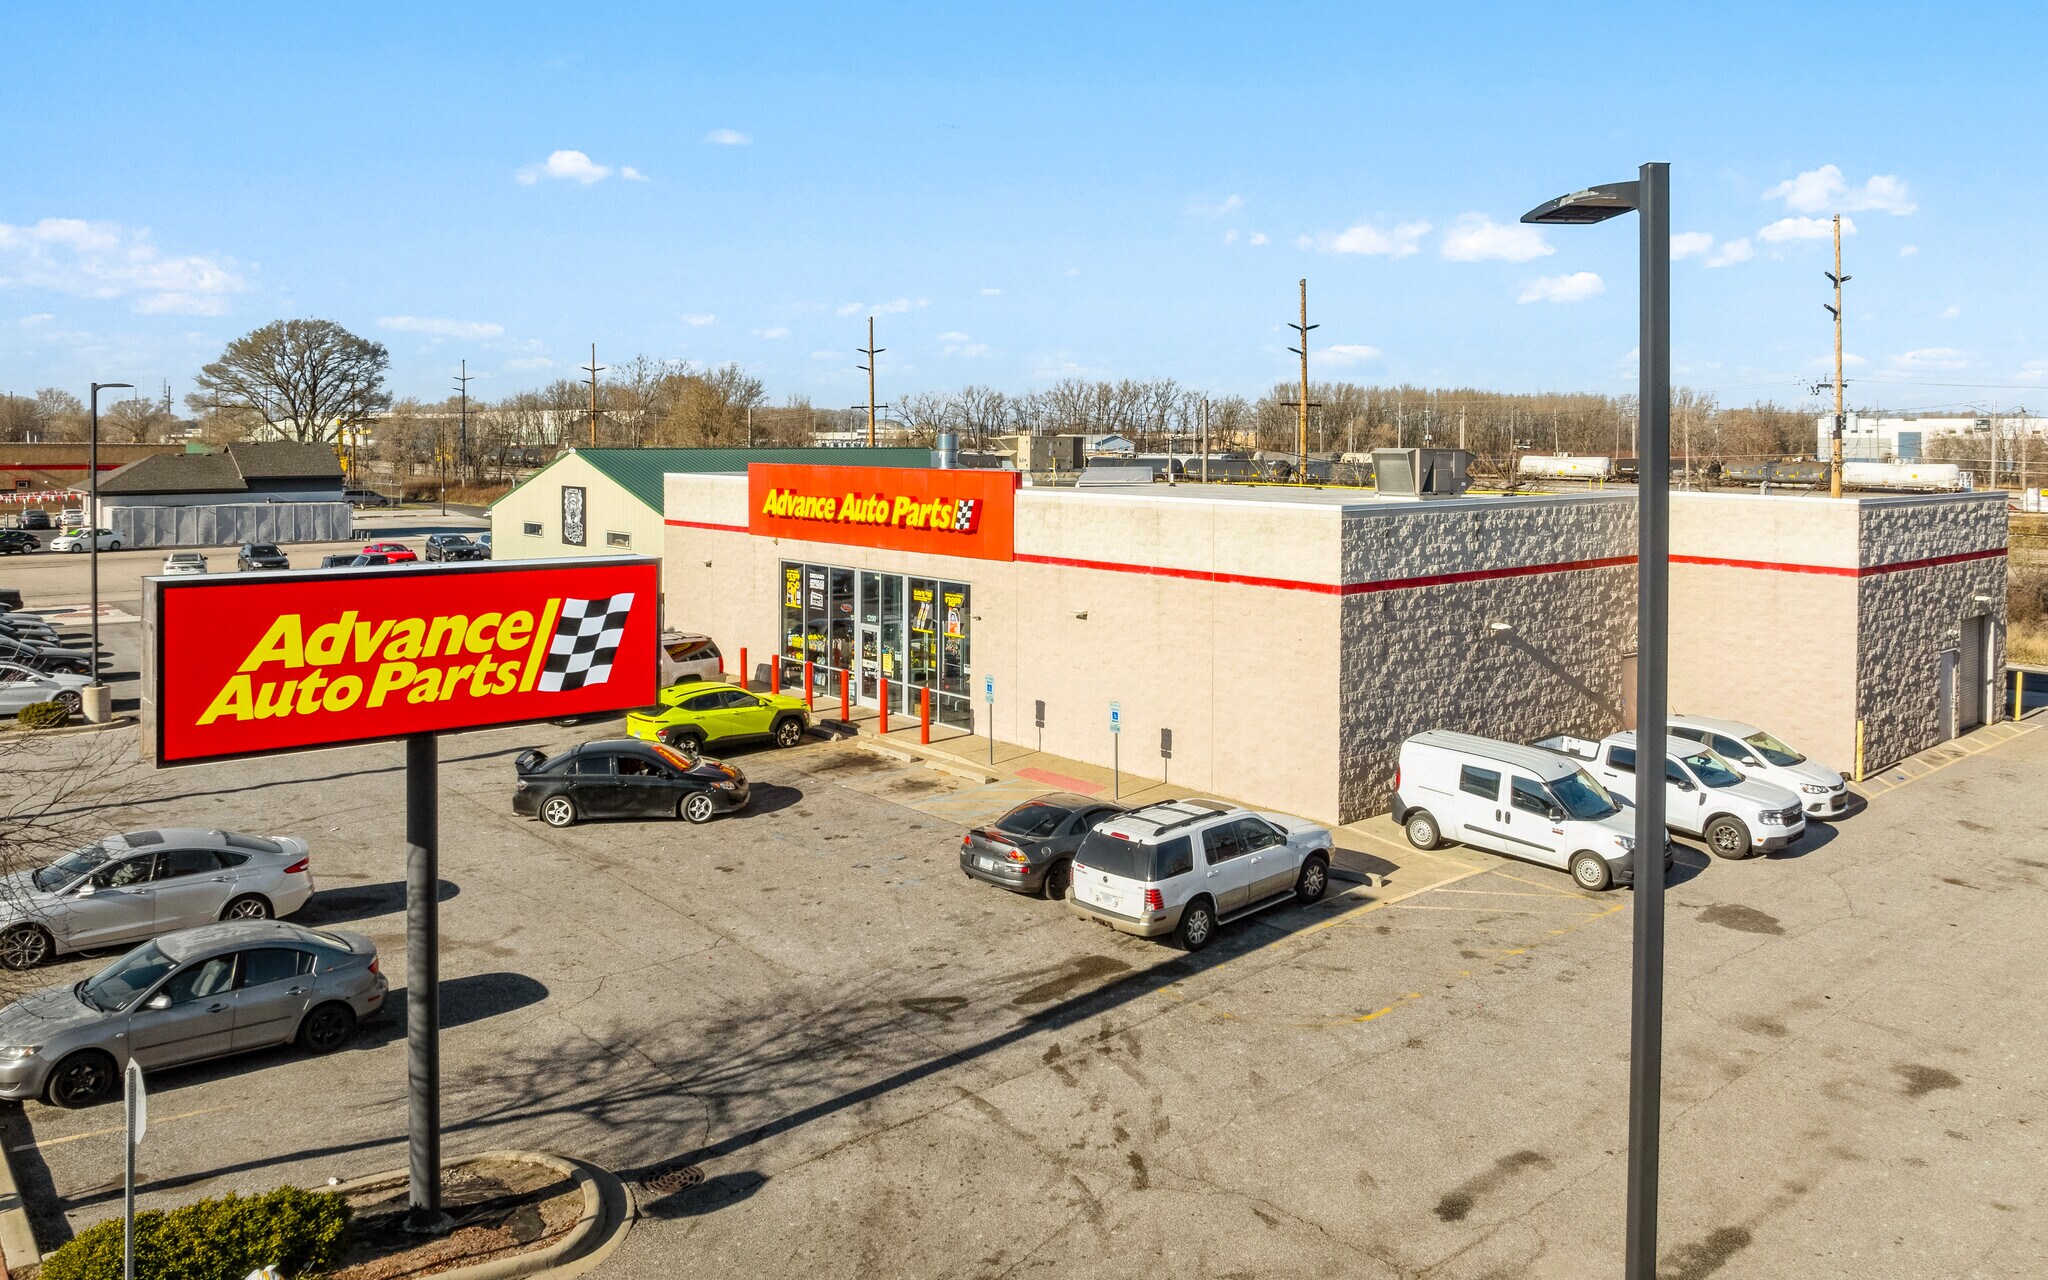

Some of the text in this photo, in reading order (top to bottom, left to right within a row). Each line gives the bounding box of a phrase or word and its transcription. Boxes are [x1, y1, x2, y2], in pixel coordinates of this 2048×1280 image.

[762, 488, 952, 529] Advance Auto Parts
[237, 611, 534, 673] Advance
[196, 654, 522, 726] Auto Parts
